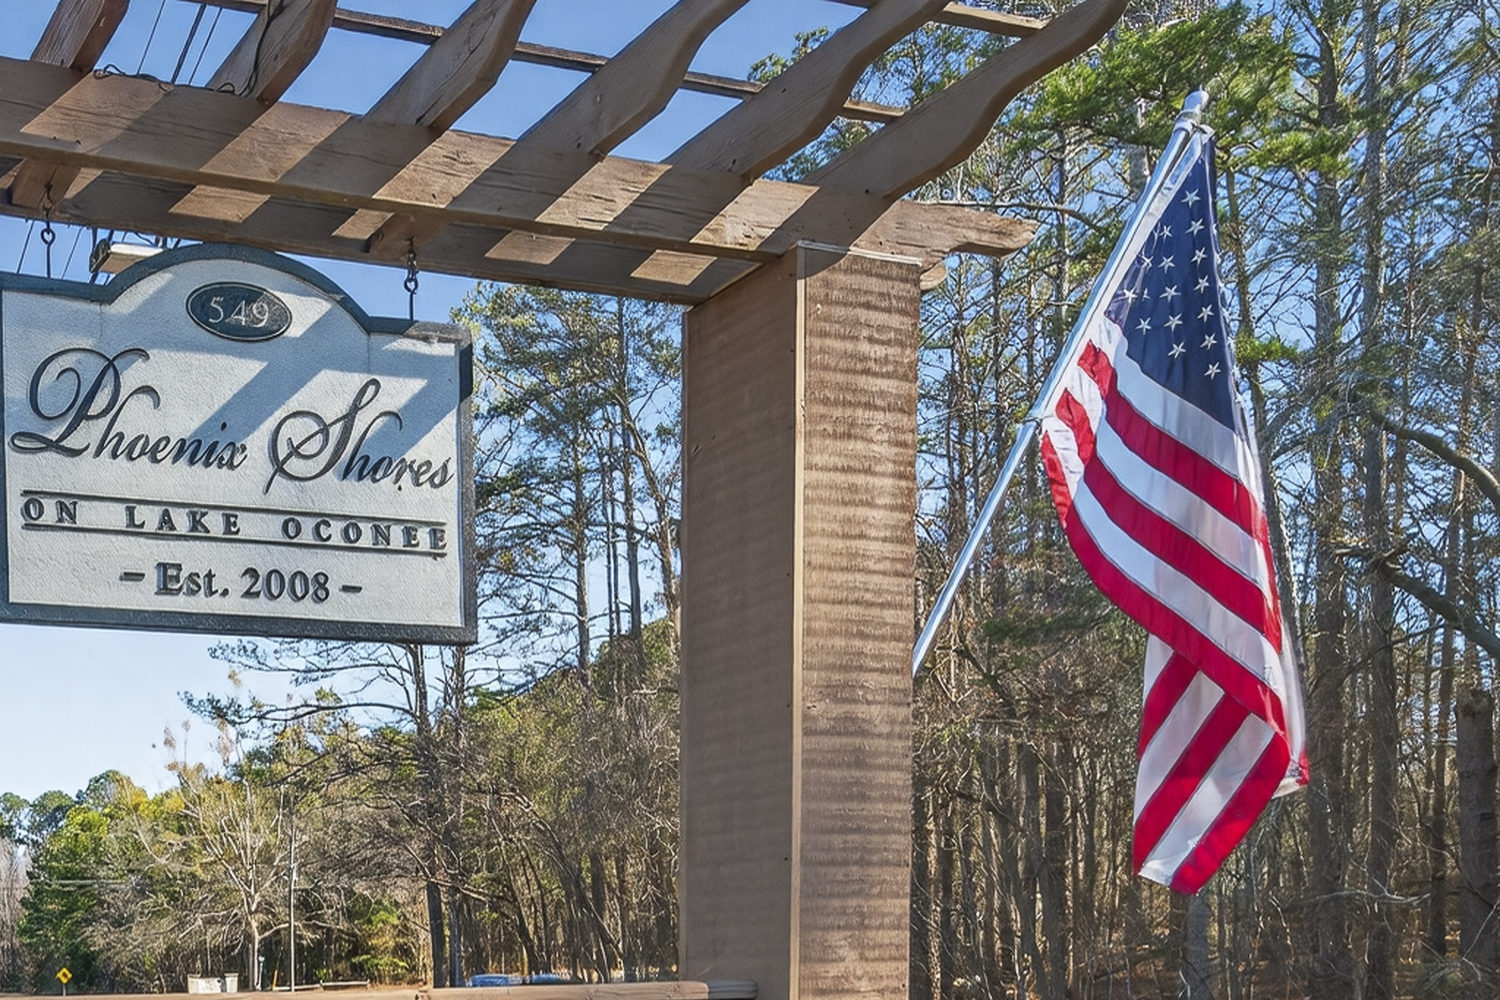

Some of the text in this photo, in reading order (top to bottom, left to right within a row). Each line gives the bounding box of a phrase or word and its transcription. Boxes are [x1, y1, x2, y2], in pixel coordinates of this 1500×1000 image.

[207, 297, 270, 328] 549
[9, 348, 455, 495] Phoenix Shores
[21, 497, 449, 551] ON LAKE OCONEE
[154, 563, 230, 598] Est.
[240, 568, 331, 602] 2008
